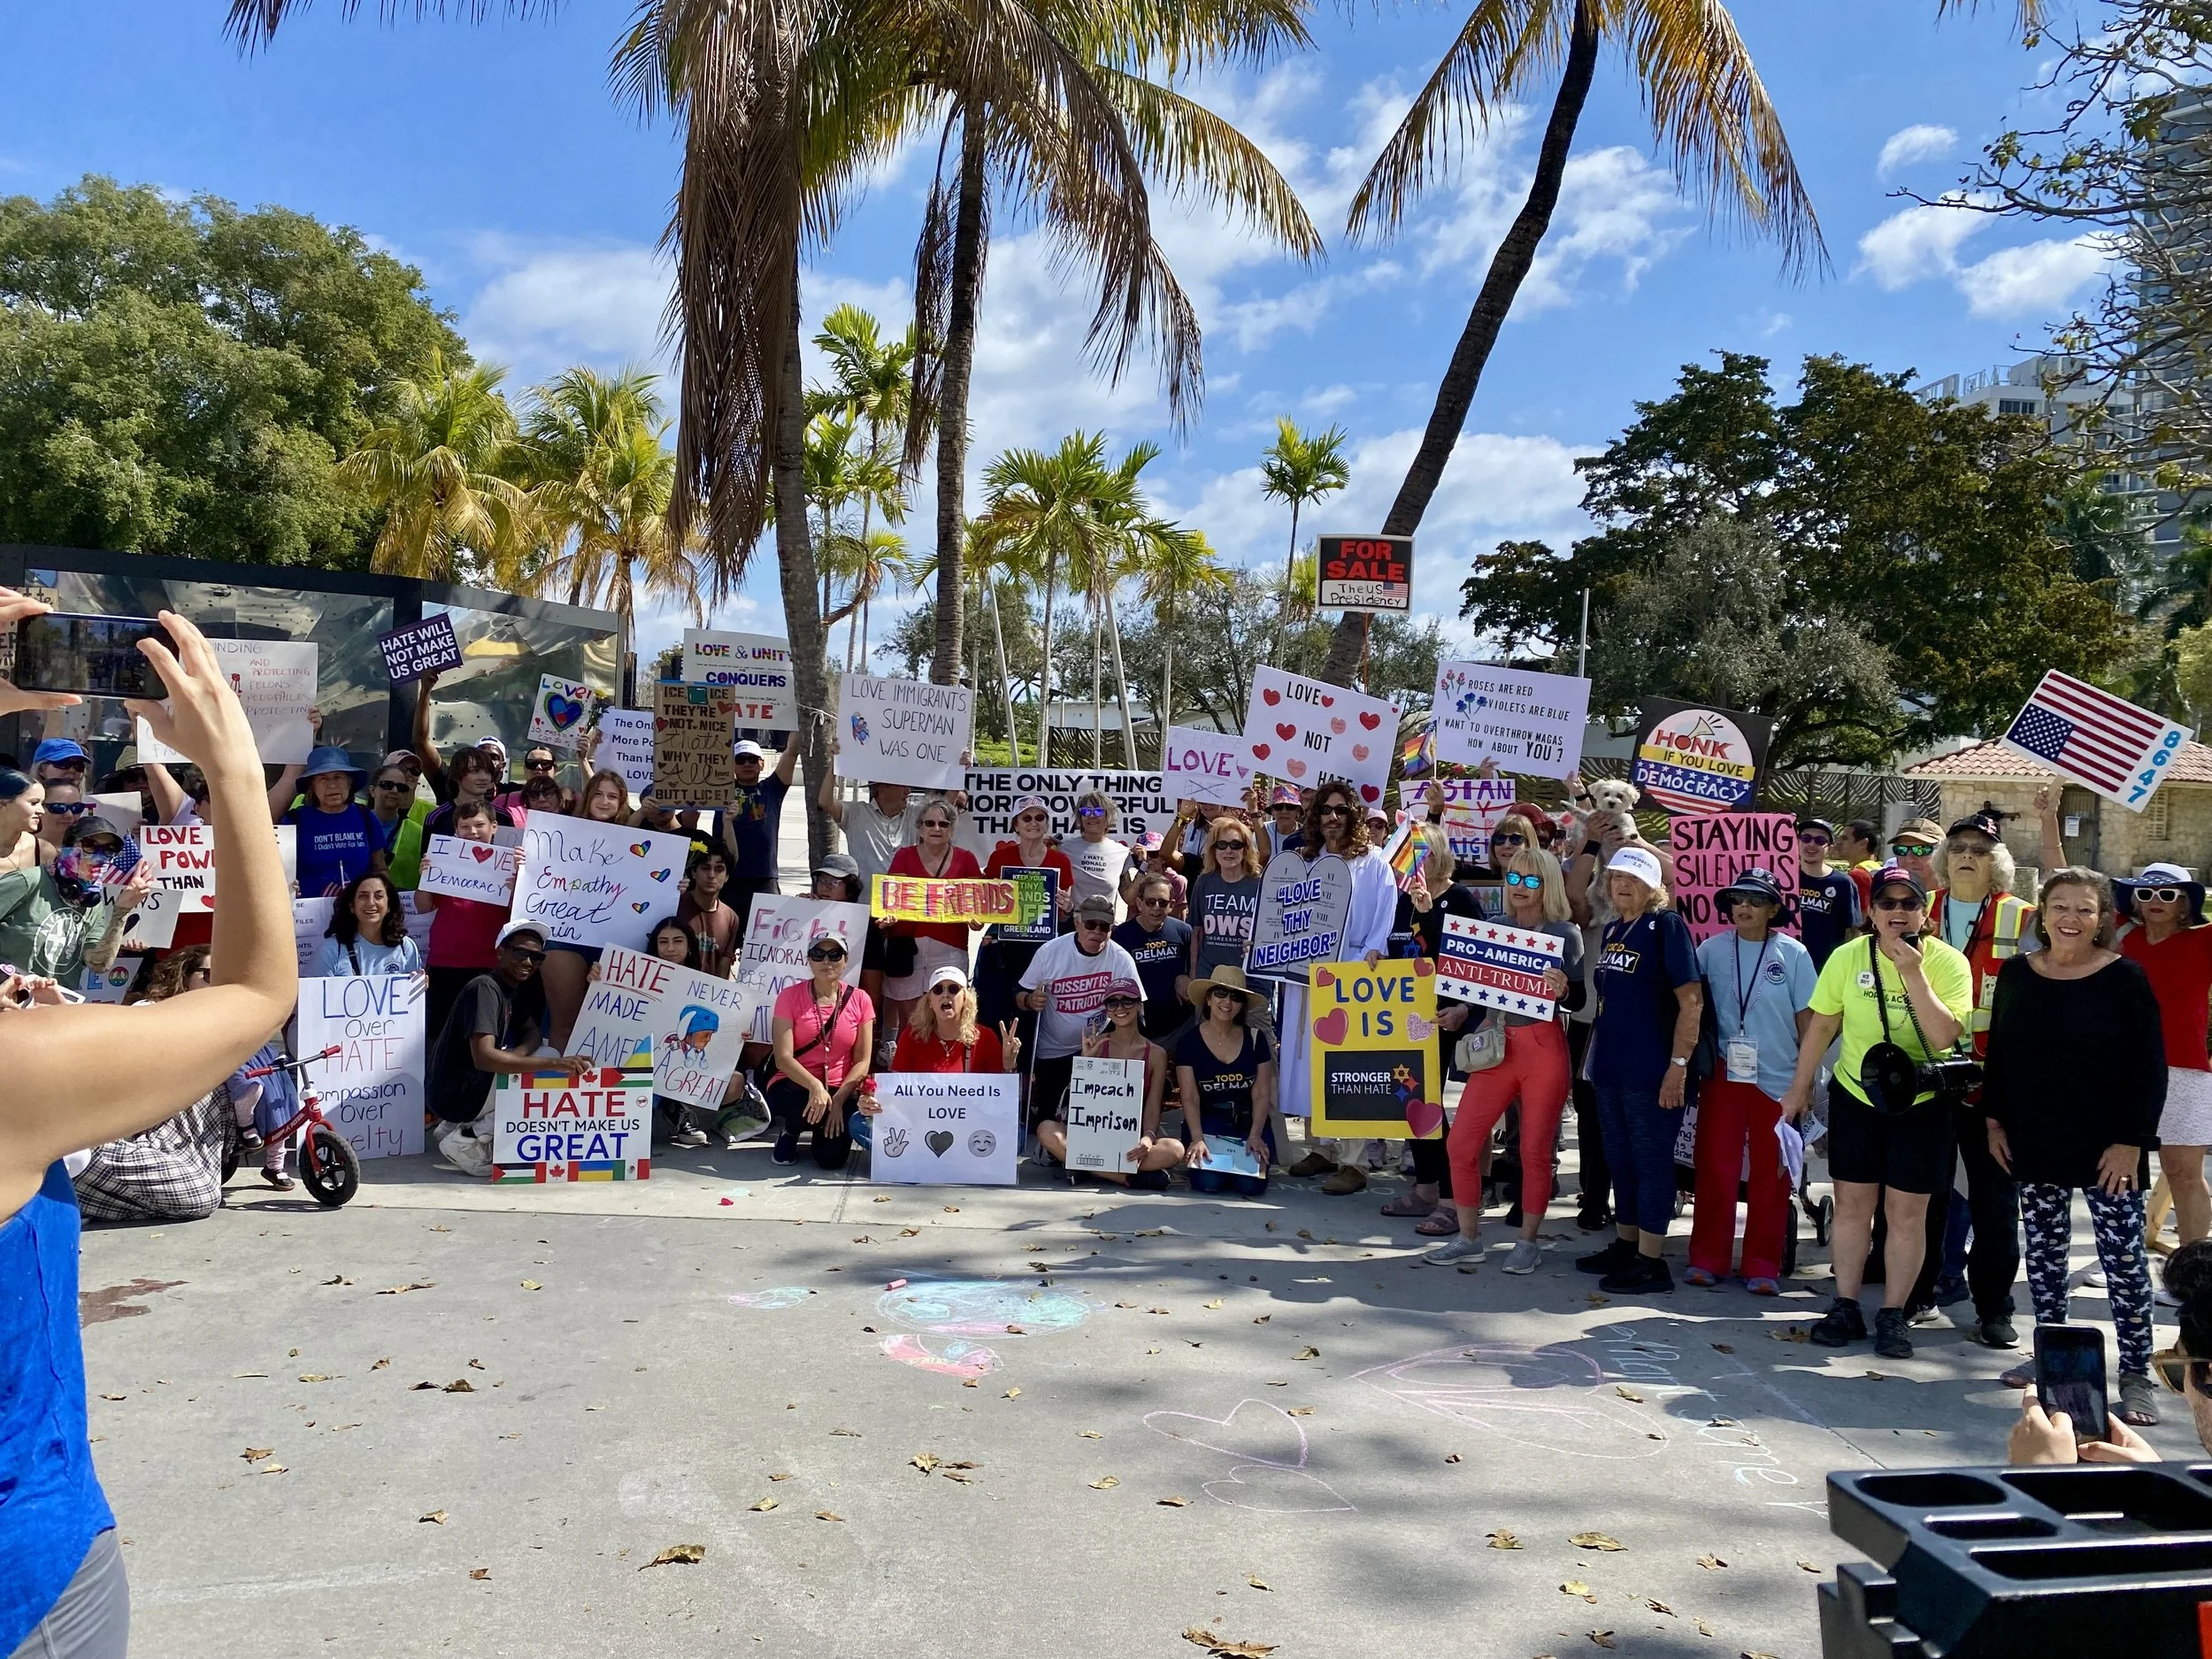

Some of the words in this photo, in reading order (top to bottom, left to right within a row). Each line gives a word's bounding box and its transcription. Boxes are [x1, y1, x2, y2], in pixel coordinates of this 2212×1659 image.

[1340, 541, 1393, 559] FOR
[1327, 561, 1405, 580] SALE
[1331, 593, 1401, 606] Presidency
[1338, 583, 1363, 594] The
[381, 631, 417, 653] HATE
[417, 621, 450, 641] WILL
[385, 647, 413, 666] NOT
[416, 634, 455, 656] MAKE
[695, 643, 730, 657] LOVE
[735, 645, 748, 659] &
[389, 664, 410, 679] US
[412, 647, 457, 672] GREAT
[706, 671, 786, 687] CONQUERS
[851, 678, 887, 701] LOVE
[1468, 680, 1494, 693] ROSES
[1499, 683, 1513, 695] ARE
[1516, 686, 1532, 696] RED
[710, 688, 728, 699] ICE
[1286, 681, 1321, 705] LOVE
[664, 704, 716, 718] THEY'RE
[734, 703, 772, 719] ATE
[1487, 699, 1525, 714] VIOLETS
[1529, 705, 1544, 717] ARE
[1547, 708, 1570, 721] BLUE
[614, 718, 634, 728] The
[635, 718, 654, 730] Onl
[699, 720, 726, 732] NICE
[880, 708, 954, 735] SUPERMAN
[1445, 718, 1465, 730] WANT
[1471, 722, 1480, 733] TO
[1484, 725, 1533, 741] OVERTHROW
[1535, 733, 1563, 746] MAGAS
[611, 735, 640, 746] More
[879, 739, 910, 757] WAS
[916, 742, 948, 764] ONE.
[1304, 731, 1332, 753] NOT
[1468, 738, 1484, 749] HOW
[1492, 741, 1518, 755] ABOUT
[1525, 741, 1552, 761] YOU
[617, 752, 642, 763] Than
[663, 750, 690, 762] WHY
[697, 754, 728, 765] THEY
[1168, 747, 1234, 776] LOVE
[1663, 750, 1674, 762] IF
[1679, 753, 1704, 768] YOU
[1709, 760, 1746, 777] LOVE
[964, 773, 1011, 792] THE
[1017, 774, 1083, 792] ONLY
[1088, 775, 1163, 793] THING
[1637, 768, 1747, 801] DEMOCRACY
[656, 789, 687, 800] BUTT
[146, 826, 204, 845] LOVE
[1123, 817, 1146, 834] IS
[1673, 818, 1794, 852] STAYING
[314, 833, 334, 843] DON'T
[334, 832, 355, 841] BLAME
[432, 839, 450, 855] I
[527, 828, 625, 865] Make
[157, 875, 204, 890] THAN
[426, 866, 505, 896] DEMOCRACY
[536, 866, 628, 907] Empathy
[882, 881, 918, 910] BE
[925, 881, 1014, 916] FRIENDS
[1018, 891, 1050, 902] ANDS
[1205, 894, 1255, 911] TEAM
[526, 893, 611, 924] Great
[1018, 904, 1051, 926] FF
[1677, 894, 1710, 925] NO
[1003, 925, 1051, 934] GREENLAND
[1204, 914, 1253, 938] DWS
[1283, 908, 1313, 933] THY
[1135, 947, 1178, 960] DELMAY
[1145, 941, 1167, 949] TODD
[1446, 939, 1552, 971] PRO-AMERICA
[606, 949, 675, 994] HATE
[1441, 960, 1553, 996] ANTI-TRUMP
[687, 979, 742, 1010] NEVER
[1054, 978, 1099, 994] DISSENT
[1099, 975, 1109, 987] IS
[1336, 977, 1415, 1002] LOVE
[323, 976, 411, 1018] LOVE
[588, 991, 649, 1021] MADE
[1362, 1010, 1394, 1037] IS
[326, 1037, 403, 1073] HATE
[664, 1067, 727, 1104] GREAT
[1203, 1078, 1256, 1092] DELMAY
[1215, 1073, 1243, 1082] TODD
[1331, 1071, 1391, 1082] STRONGER
[894, 1085, 913, 1096] All
[918, 1085, 943, 1096] You
[948, 1086, 984, 1096] Need
[988, 1086, 1001, 1096] Is
[1071, 1078, 1134, 1099] Impeach
[1331, 1084, 1361, 1094] THAN
[1364, 1084, 1391, 1094] HATE
[523, 1091, 626, 1118] HATE
[928, 1108, 966, 1118] LOVE
[506, 1121, 570, 1133] DOESN'T
[575, 1119, 616, 1132] MAKE
[621, 1119, 640, 1130] US
[1070, 1106, 1138, 1133] Imprison
[517, 1133, 629, 1162] GREAT
